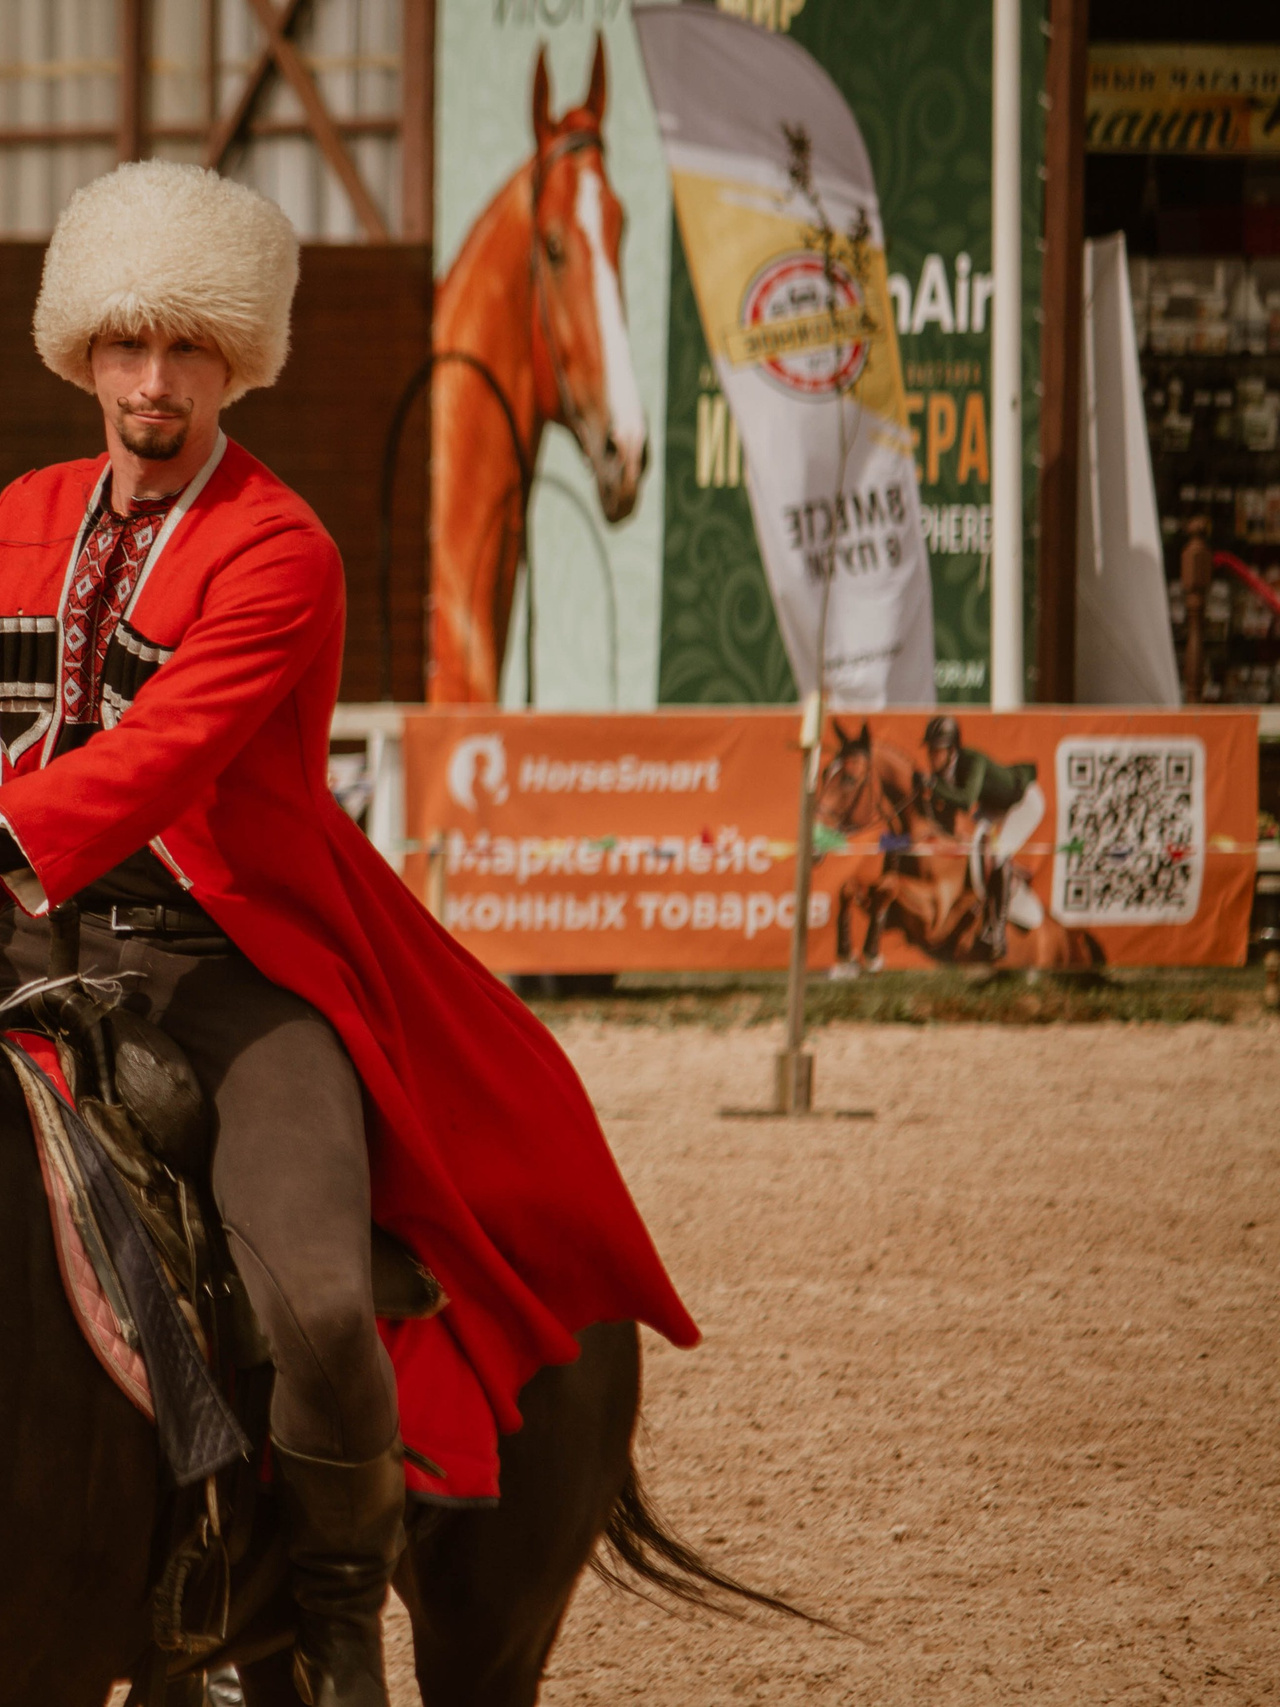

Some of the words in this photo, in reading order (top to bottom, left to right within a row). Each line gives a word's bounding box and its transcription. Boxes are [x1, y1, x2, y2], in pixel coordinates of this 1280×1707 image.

[520, 755, 720, 793] HorseSmart
[447, 827, 772, 884] Маркетплейс
[446, 893, 625, 931] конных
[635, 893, 832, 938] товаров
